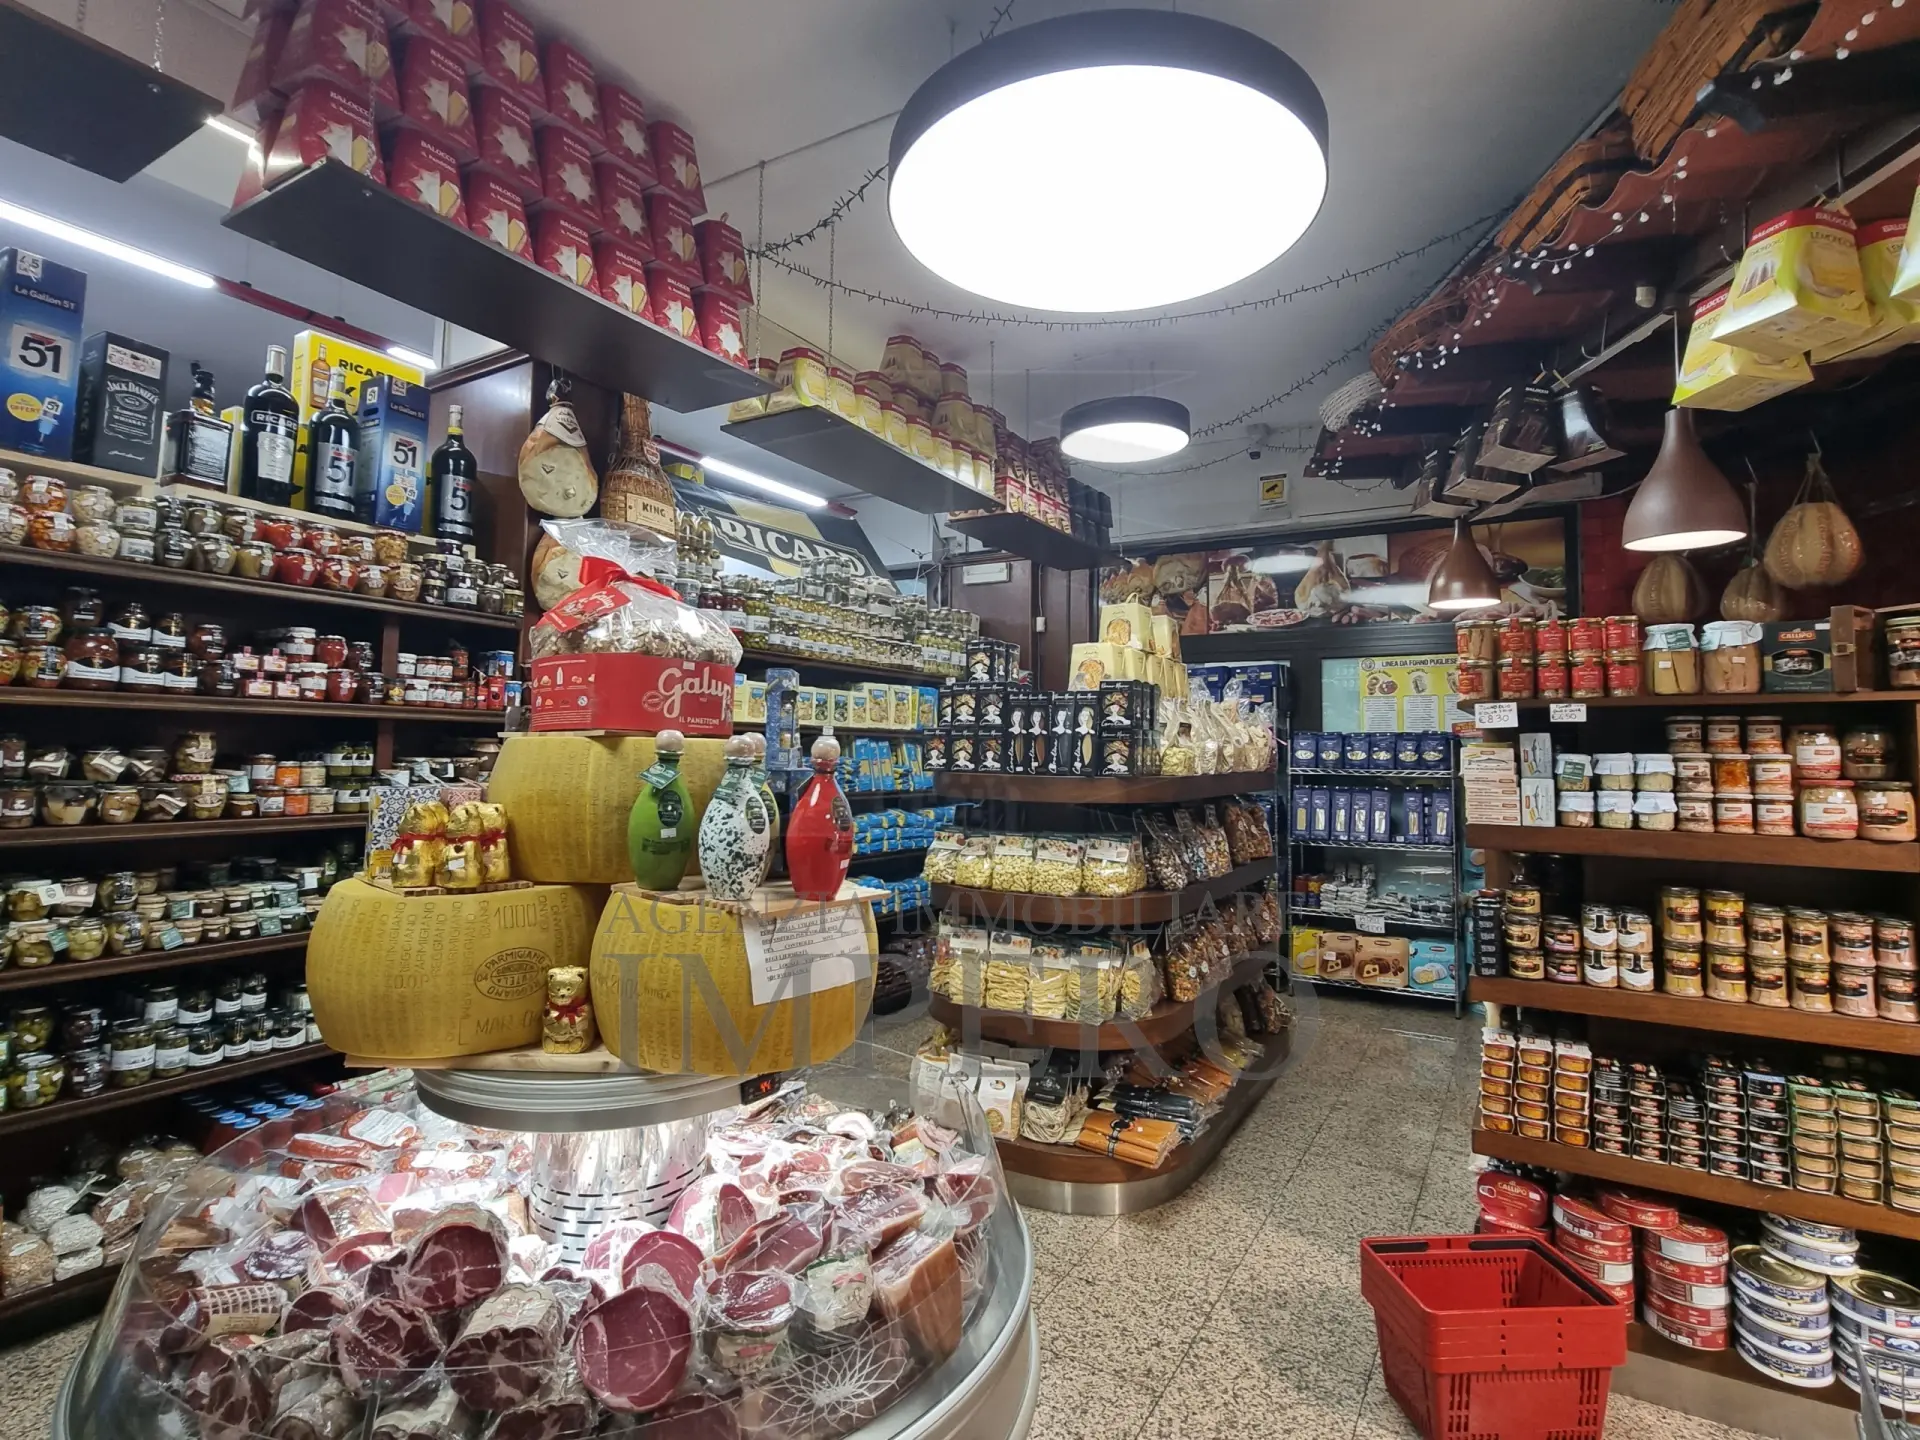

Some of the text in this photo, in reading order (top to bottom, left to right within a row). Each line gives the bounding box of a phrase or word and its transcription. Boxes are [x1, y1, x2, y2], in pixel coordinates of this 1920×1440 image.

[420, 140, 456, 165] BALOCCO
[489, 182, 522, 203] BALOCCO
[559, 219, 589, 238] BALOCCO
[1751, 220, 1787, 241] BALOCCO
[615, 250, 642, 267] BALOCCO
[667, 277, 691, 292] BALOCCO
[14, 284, 76, 310] Le Gallon 51
[18, 335, 62, 374] 51
[338, 358, 393, 377] RICAR
[107, 380, 128, 393] JACK
[128, 382, 160, 404] DANIEL'S
[368, 389, 376, 402] 51
[46, 400, 60, 412] 51
[399, 404, 418, 417] Gallon
[256, 413, 298, 431] RICARD
[393, 441, 417, 468] 51
[325, 456, 355, 487] 51
[407, 488, 417, 498] 51
[450, 487, 471, 514] 51
[641, 501, 666, 517] KING
[715, 516, 866, 577] RICARD
[1779, 631, 1814, 640] CALLIPO
[1381, 660, 1399, 668] LINEA
[1429, 657, 1457, 666] PUGLIESE
[657, 666, 732, 722] Galup
[687, 717, 720, 726] PANETTONE
[484, 948, 547, 970] PARMIGIANO
[1497, 1182, 1527, 1196] CALLIPO
[1636, 1213, 1661, 1222] CALLIPO
[1584, 1246, 1609, 1256] CALLIPO
[1655, 1259, 1681, 1273] CALLIPO
